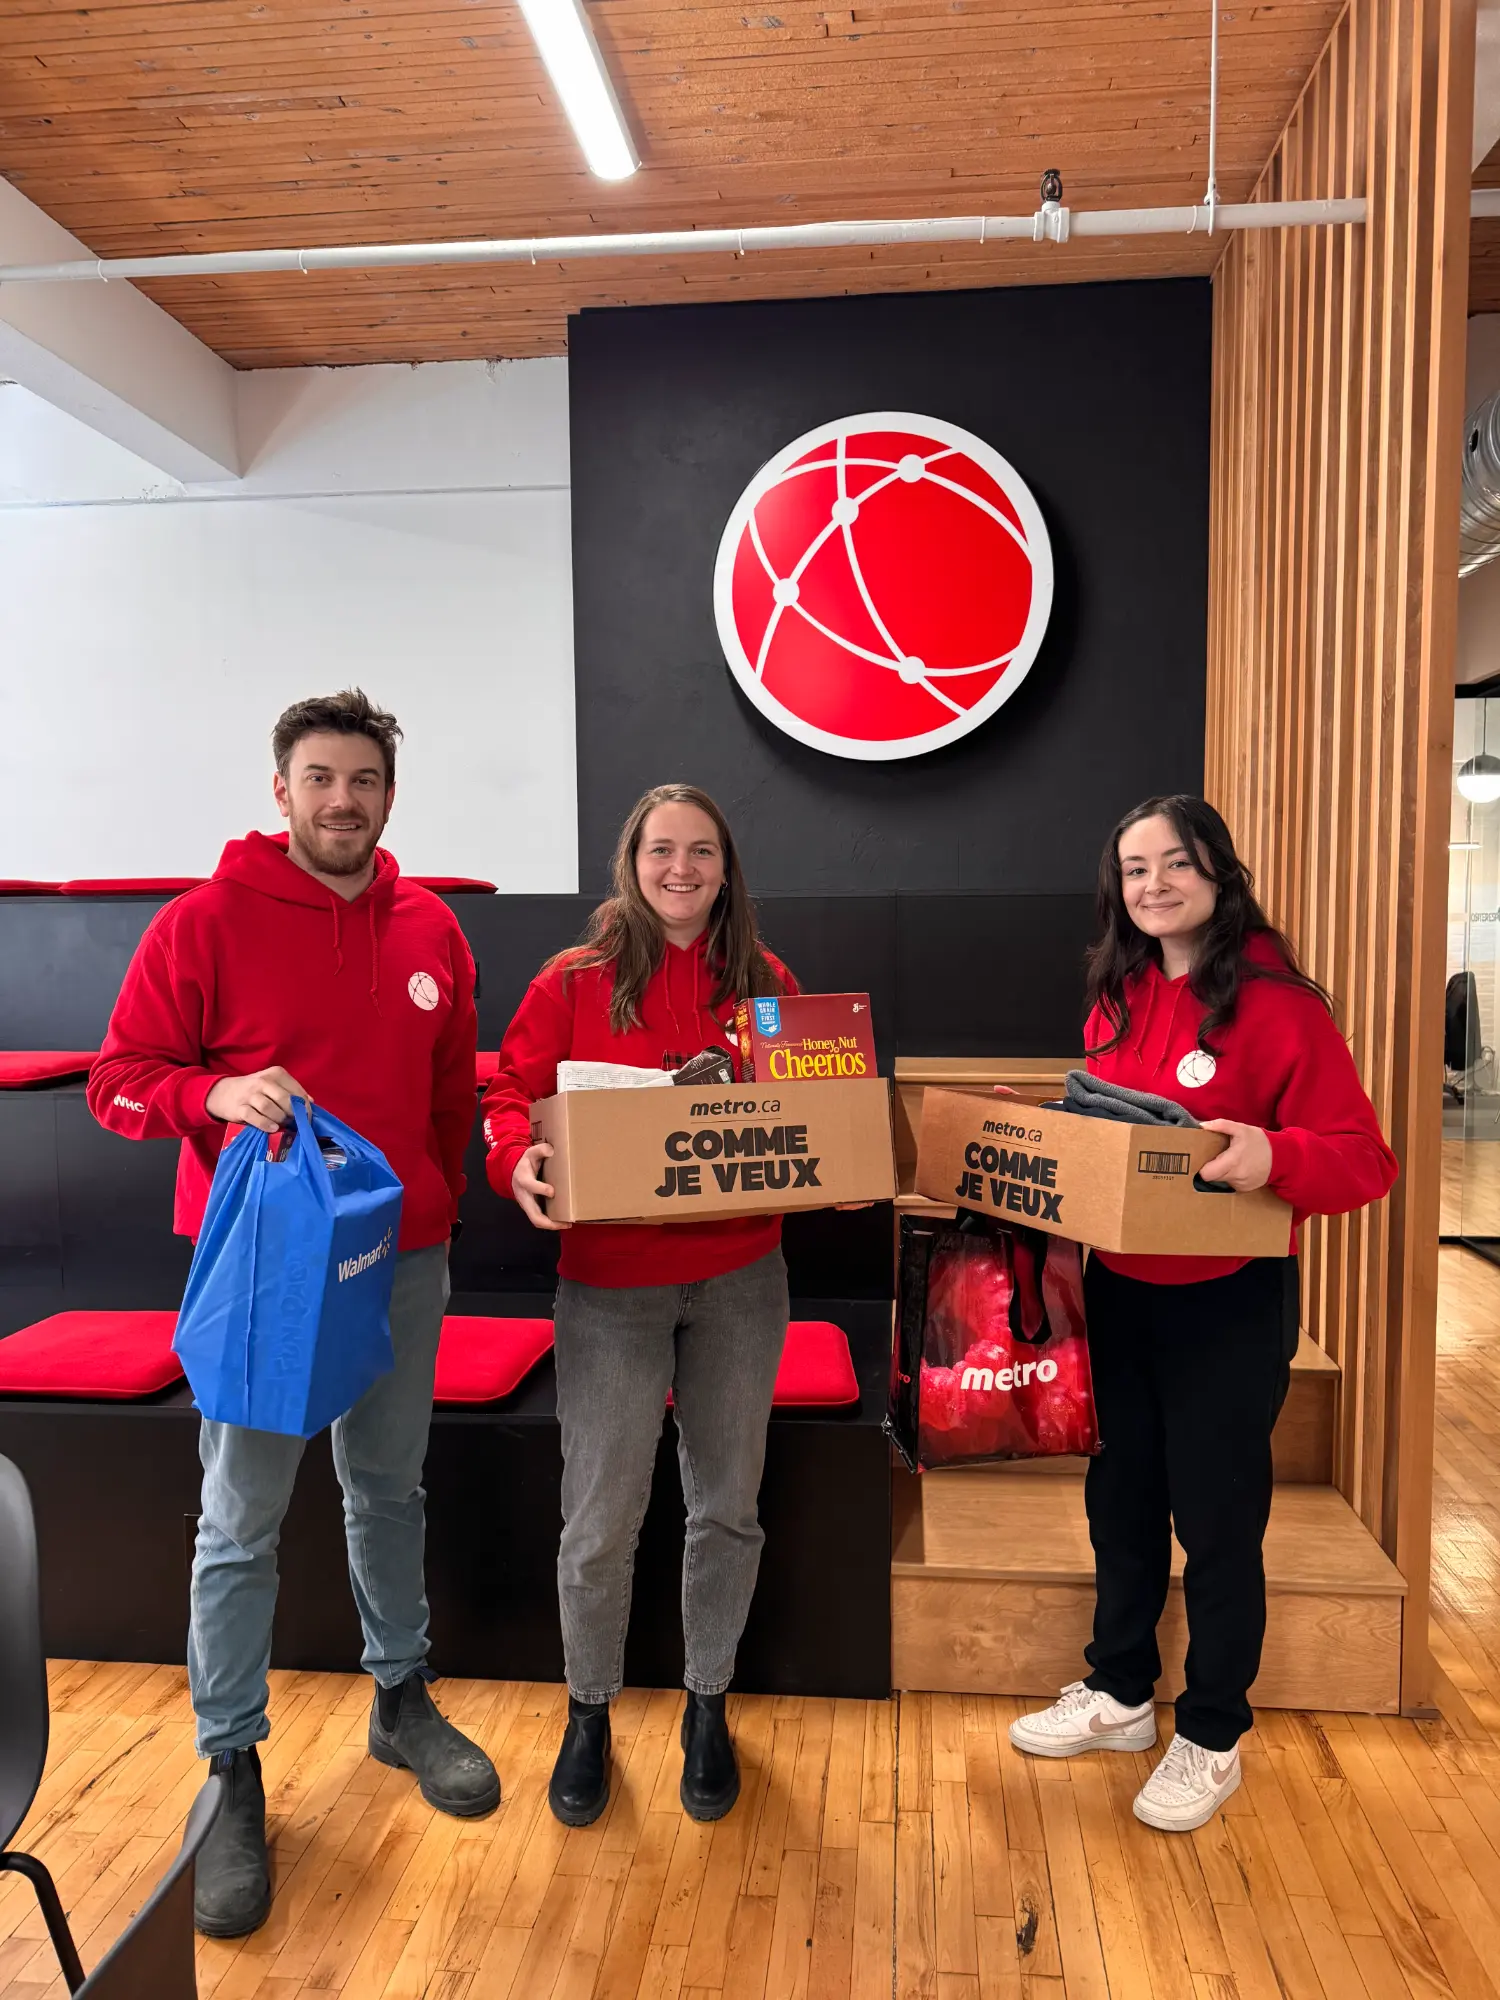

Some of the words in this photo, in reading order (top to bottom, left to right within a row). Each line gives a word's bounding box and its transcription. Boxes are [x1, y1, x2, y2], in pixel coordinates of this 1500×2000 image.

[802, 1038, 836, 1053] Honey
[838, 1036, 858, 1049] Nut
[769, 1048, 867, 1080] Cheerios
[113, 1094, 146, 1113] WHC
[690, 1099, 781, 1117] metro.ca
[664, 1125, 809, 1162] COMME
[982, 1120, 1043, 1142] metro.ca
[655, 1165, 702, 1198] JE
[712, 1157, 823, 1193] VEUX
[964, 1141, 1059, 1188] COMME
[955, 1171, 984, 1202] JE
[989, 1177, 1065, 1224] VEUX
[338, 1239, 383, 1283] Walmart
[960, 1358, 1058, 1391] metro
